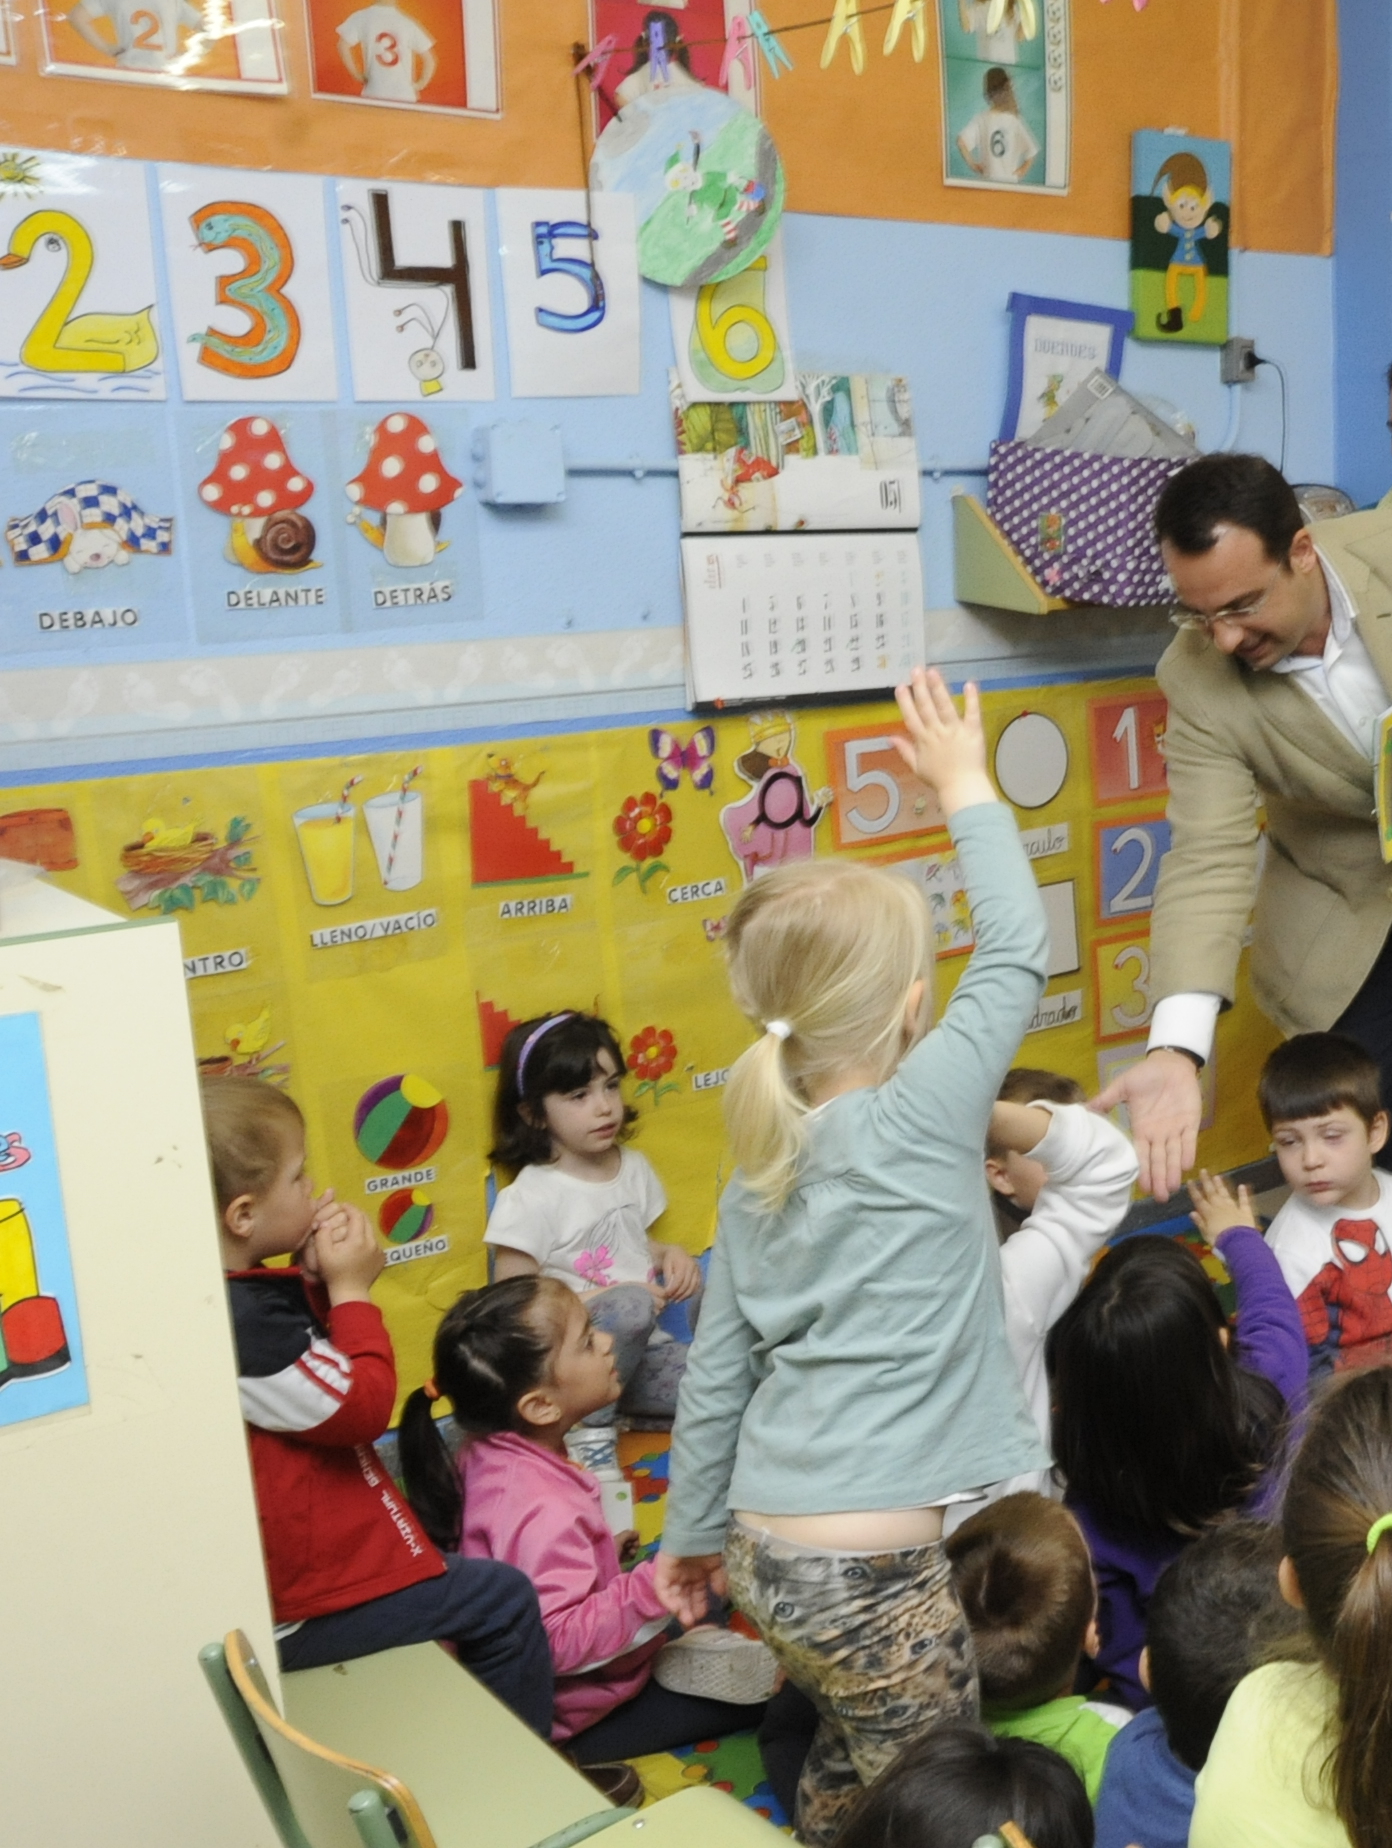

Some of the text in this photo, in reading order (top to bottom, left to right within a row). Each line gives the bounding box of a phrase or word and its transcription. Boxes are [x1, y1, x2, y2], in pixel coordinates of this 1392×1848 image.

[130, 10, 163, 51] 2
[375, 32, 399, 67] 3
[990, 131, 1006, 158] 6
[9, 189, 777, 380] 2 3 4 5 6
[226, 587, 325, 608] DELANTE
[373, 581, 453, 607] DETRÁS
[38, 608, 140, 631] DEBAJO
[1112, 706, 1140, 789] 1
[844, 736, 900, 834] 5
[1109, 827, 1156, 914] 2
[500, 897, 570, 918] ARRIBA
[667, 880, 725, 903] CERCA
[310, 910, 437, 947] LLENO/VACÍO
[1112, 946, 1151, 1028] 3
[366, 1168, 435, 1192] GRANDE
